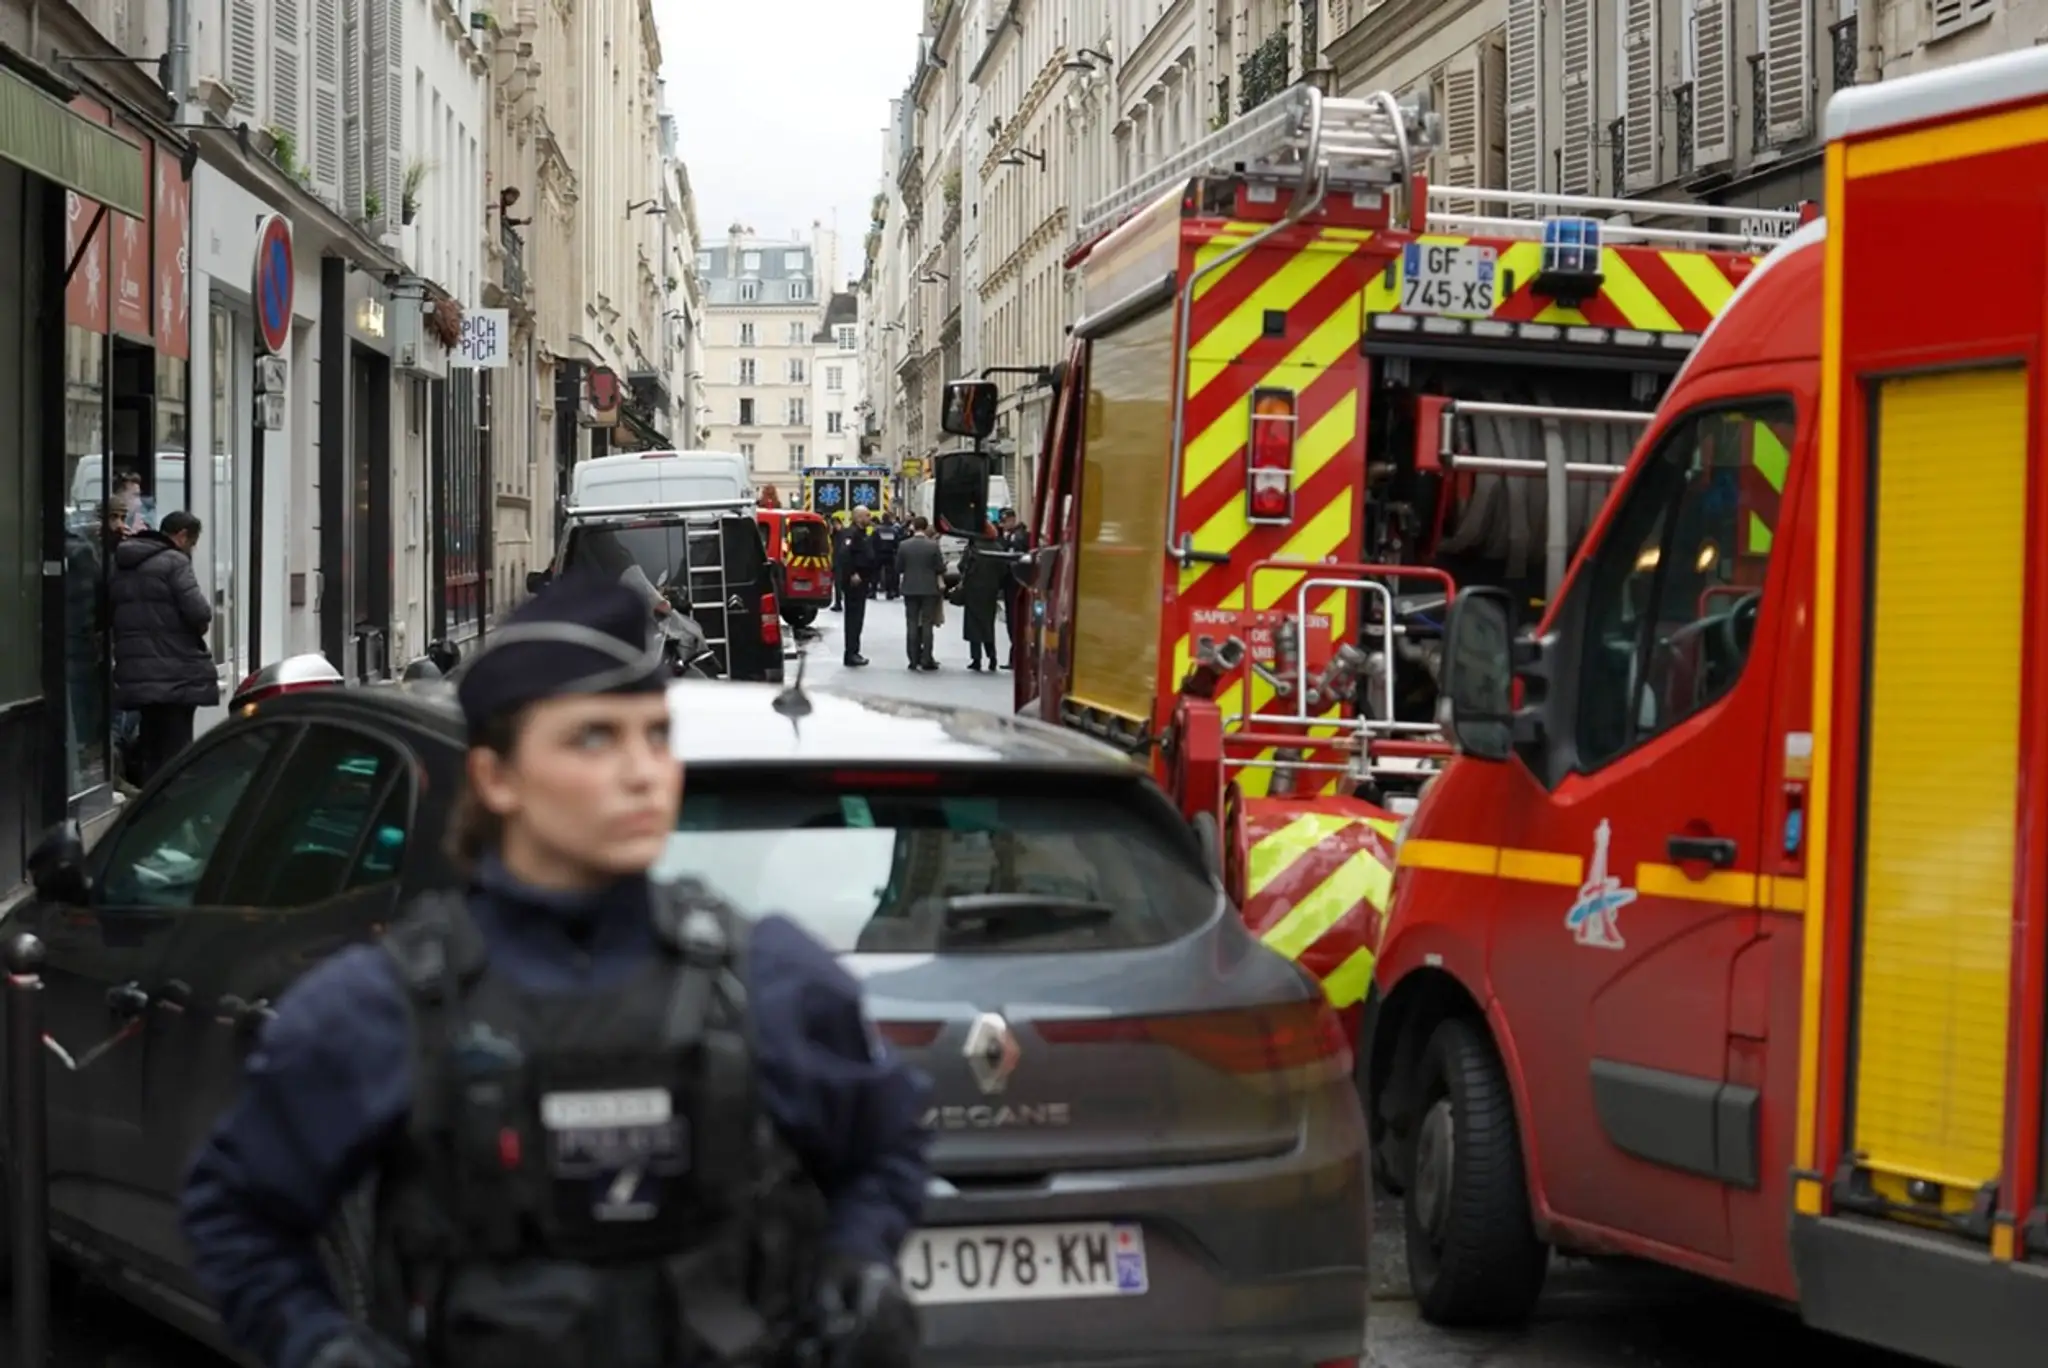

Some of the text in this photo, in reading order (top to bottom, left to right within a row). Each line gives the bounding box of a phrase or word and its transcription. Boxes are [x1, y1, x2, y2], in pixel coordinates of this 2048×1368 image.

[1405, 279, 1492, 310] 745-XS
[462, 316, 496, 337] PICH
[909, 1232, 1113, 1291] J-078-KH
